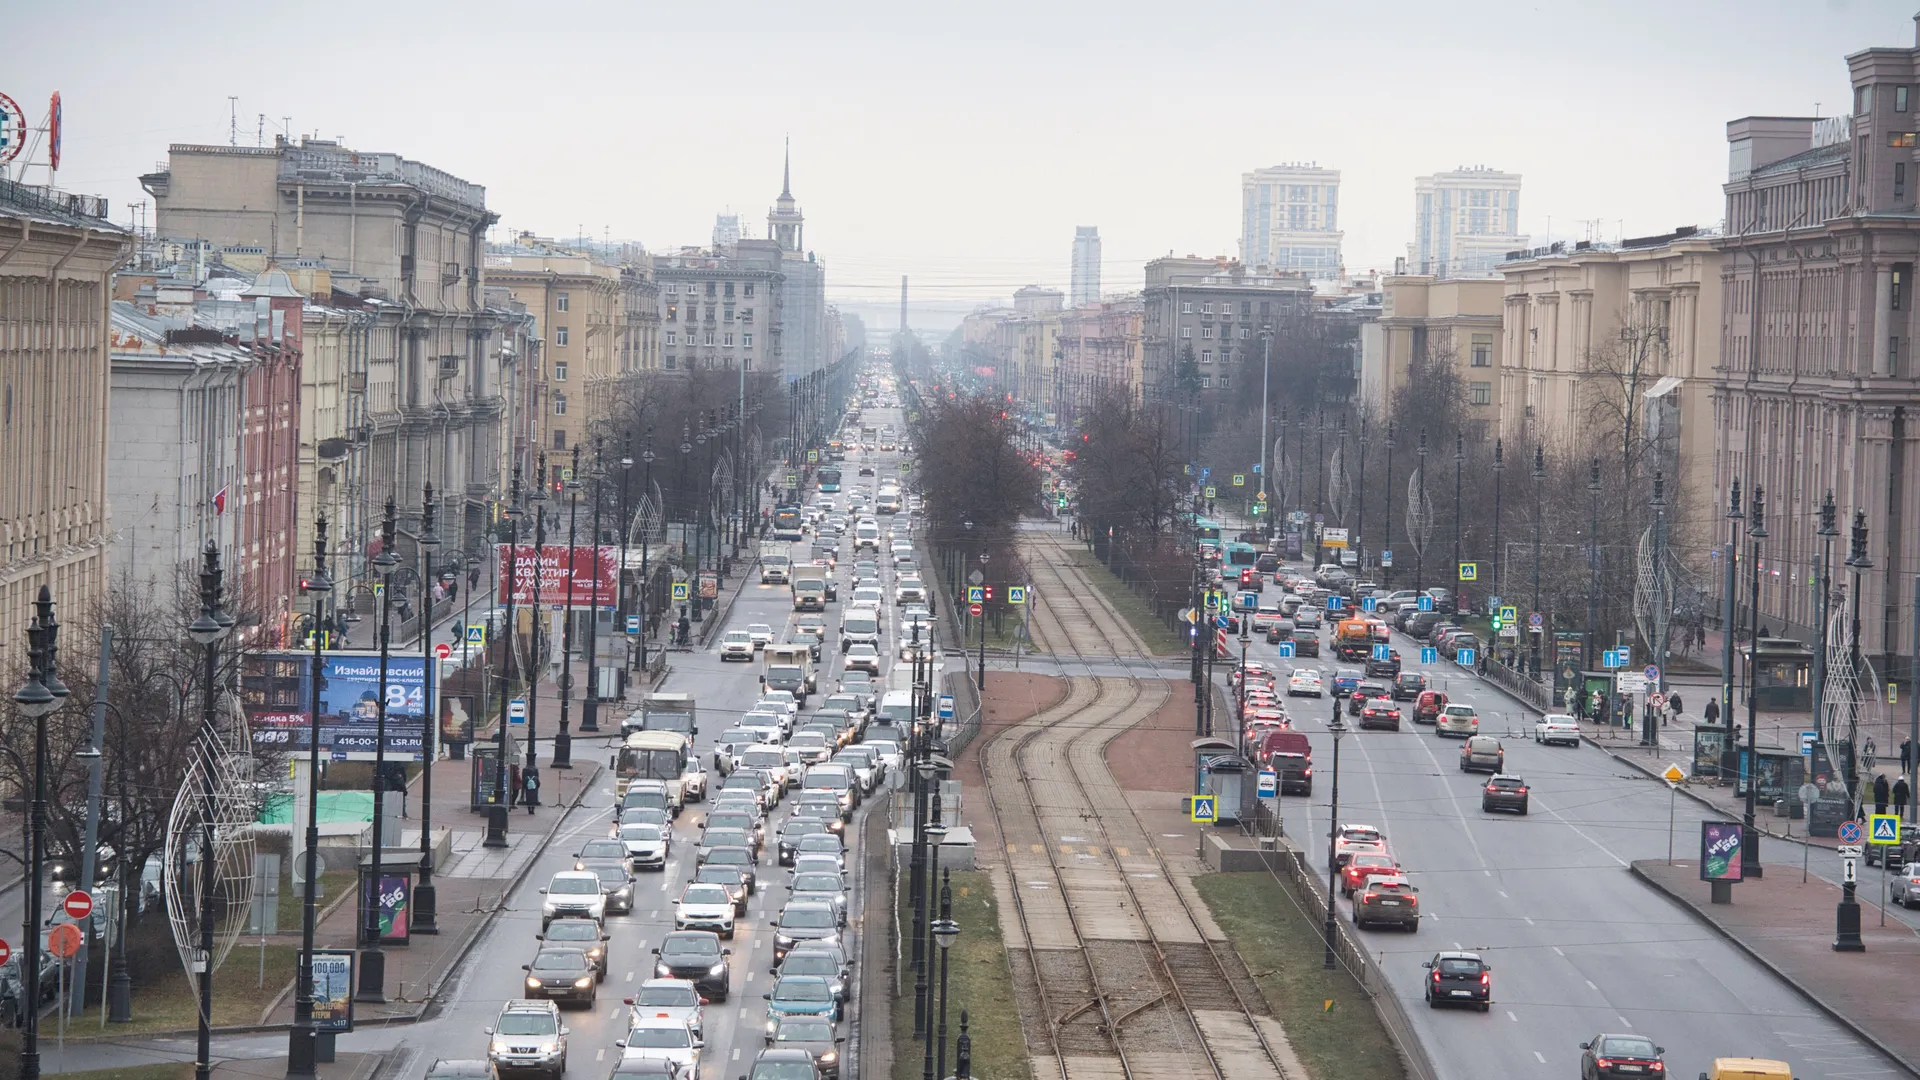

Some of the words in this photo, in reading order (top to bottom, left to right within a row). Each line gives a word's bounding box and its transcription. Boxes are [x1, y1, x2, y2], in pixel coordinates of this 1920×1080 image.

[515, 578, 524, 587] У
[335, 665, 424, 676] Измайлвский
[390, 738, 422, 746] LSR.RU
